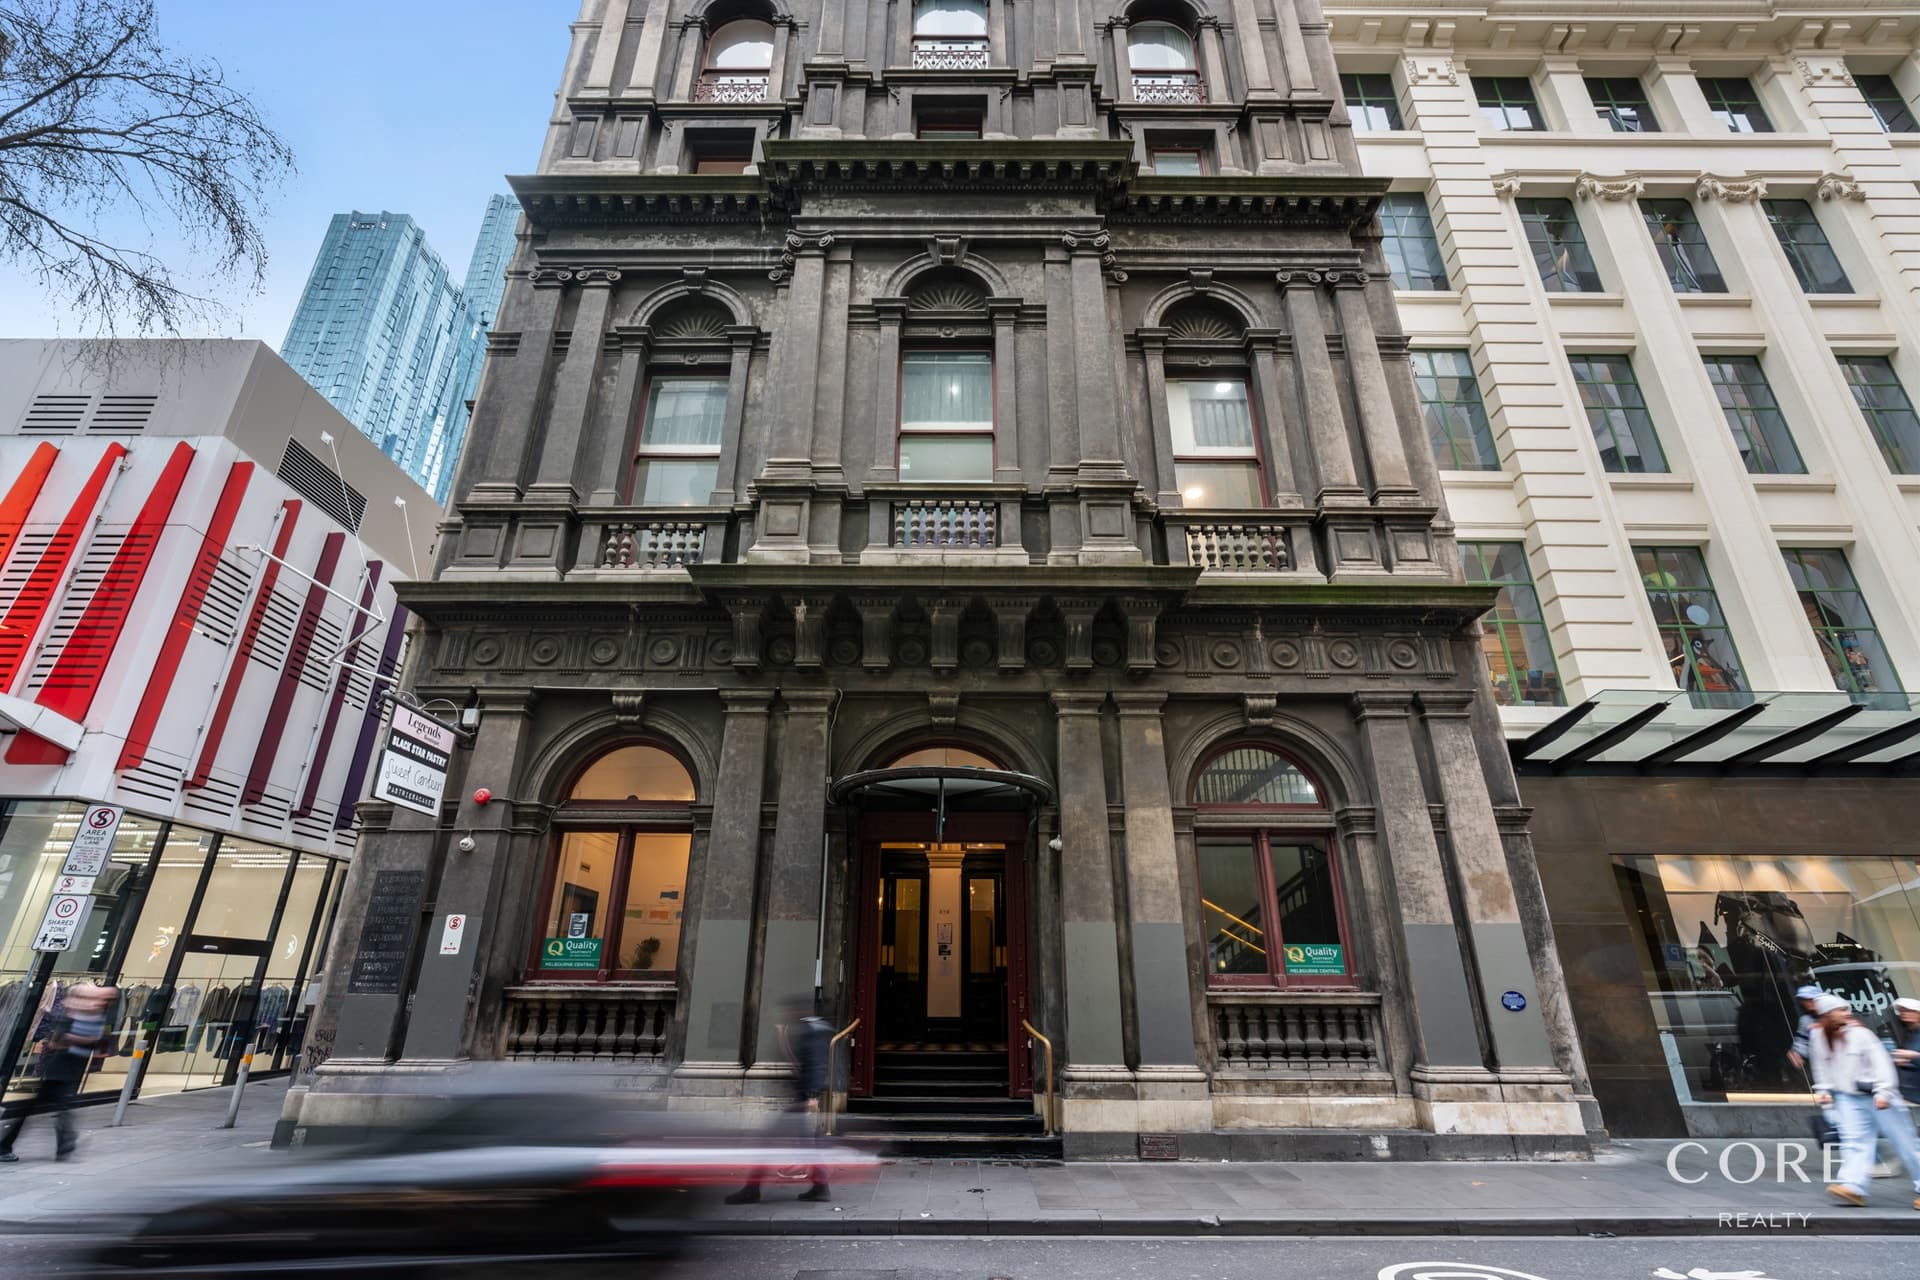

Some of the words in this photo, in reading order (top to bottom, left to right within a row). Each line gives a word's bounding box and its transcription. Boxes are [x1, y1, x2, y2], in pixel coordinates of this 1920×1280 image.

[408, 713, 441, 739] Legends
[391, 735, 412, 752] BLACK
[411, 744, 427, 759] STAR
[426, 751, 447, 767] PASTRY
[385, 758, 412, 782] Sweet
[61, 904, 72, 913] 10
[566, 940, 598, 951] Quality
[1305, 946, 1338, 958] Quality
